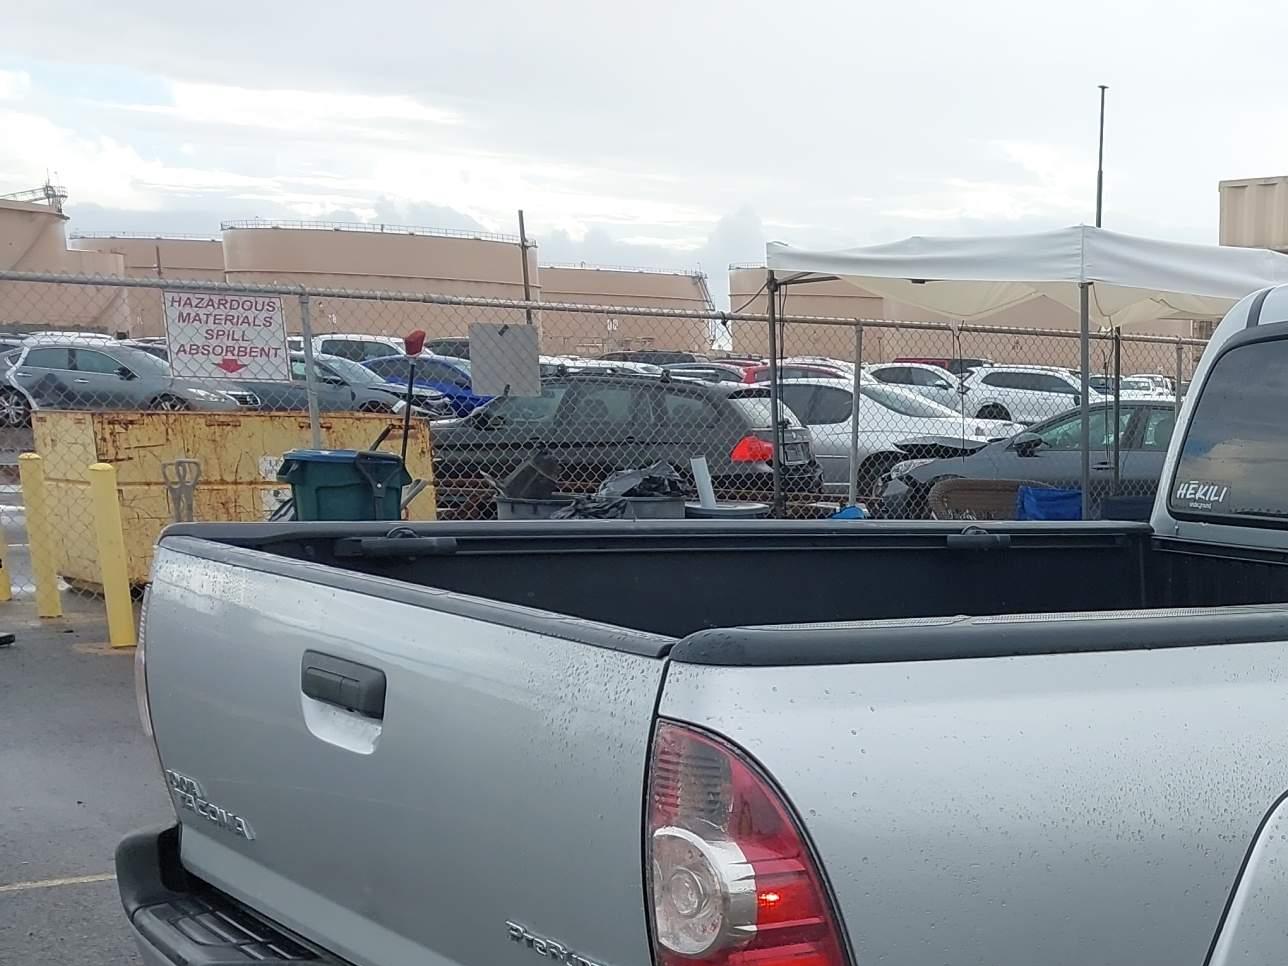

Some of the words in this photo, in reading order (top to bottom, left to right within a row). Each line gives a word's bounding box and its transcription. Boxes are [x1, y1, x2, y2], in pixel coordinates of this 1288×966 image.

[170, 295, 276, 312] HAZARDOUS
[177, 311, 273, 328] MATERIALS
[204, 328, 250, 342] SPILL
[175, 343, 281, 358] ABSORBENT
[174, 786, 256, 840] TACOMA
